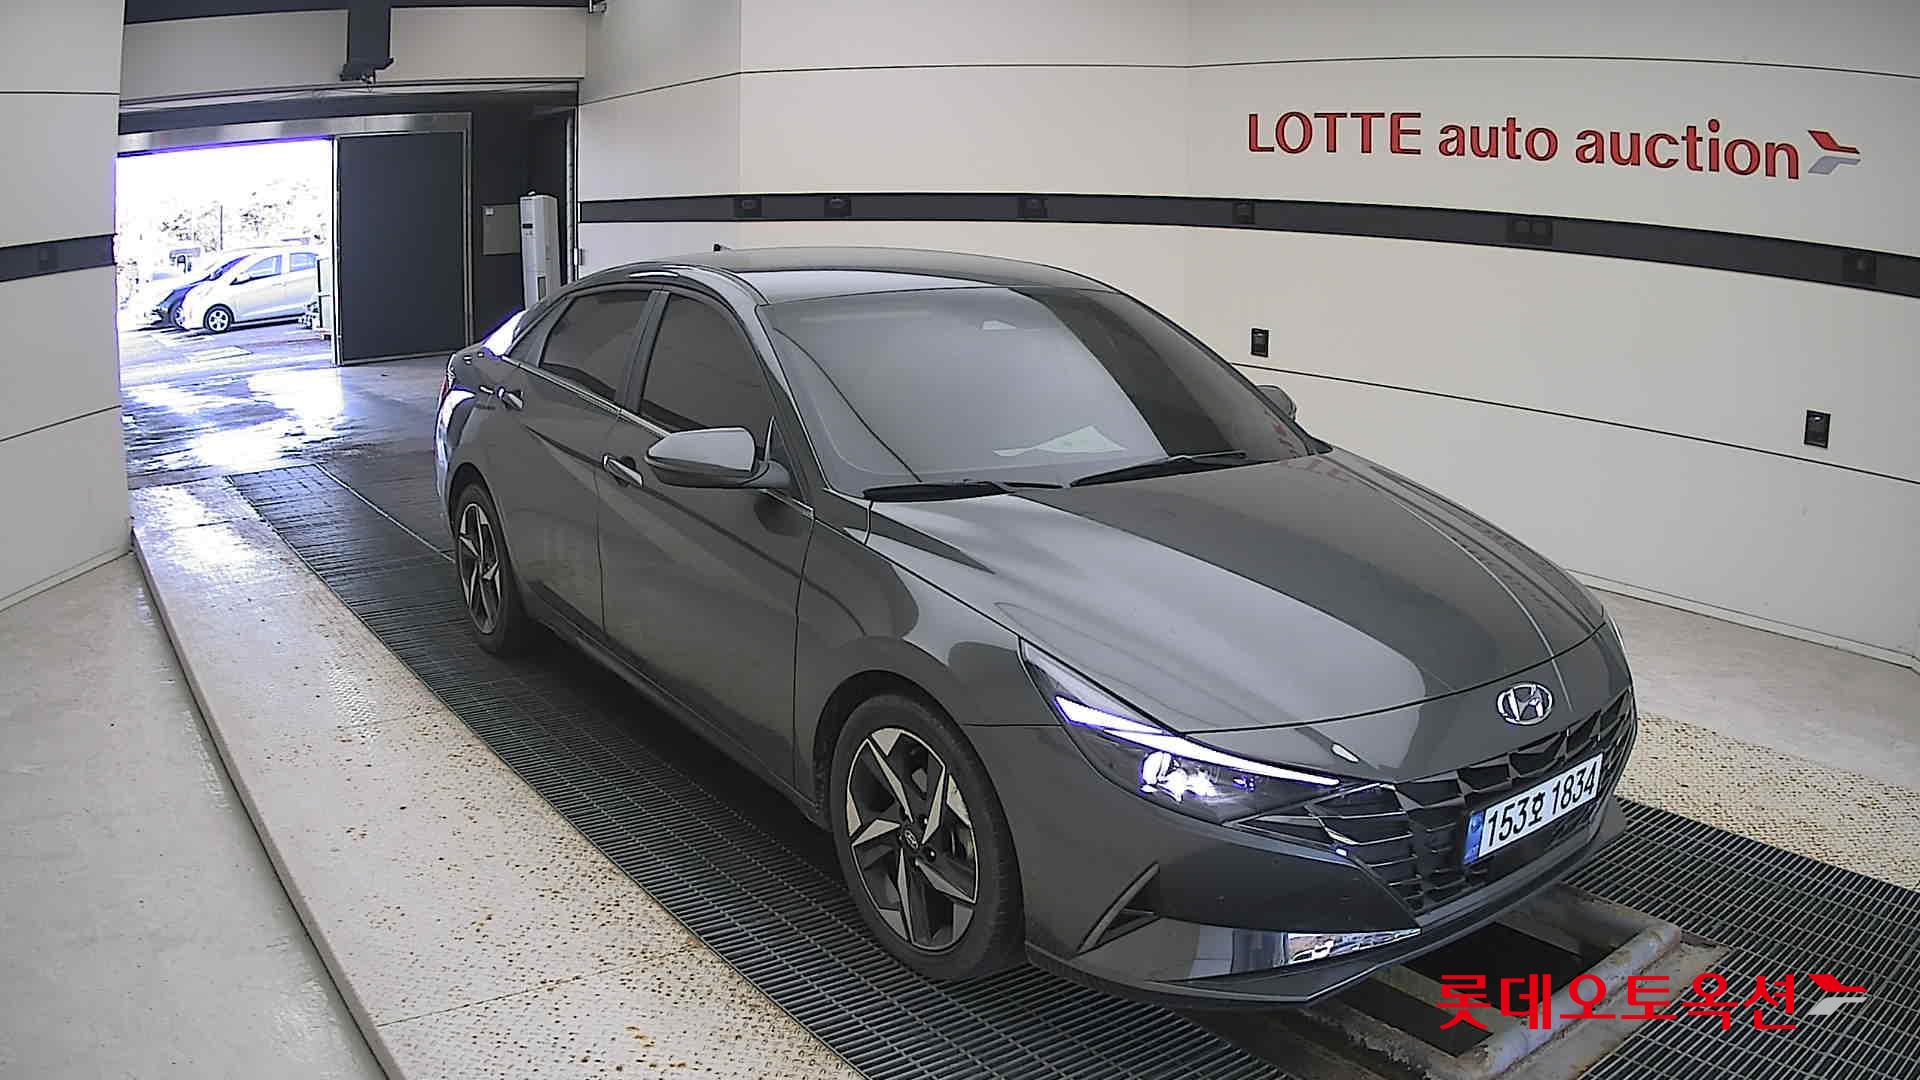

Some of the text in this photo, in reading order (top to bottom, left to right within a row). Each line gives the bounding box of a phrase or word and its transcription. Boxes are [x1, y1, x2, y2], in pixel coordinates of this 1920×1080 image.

[1247, 111, 1800, 179] LOTTE auto auction
[1488, 761, 1598, 847] 153호 1834
